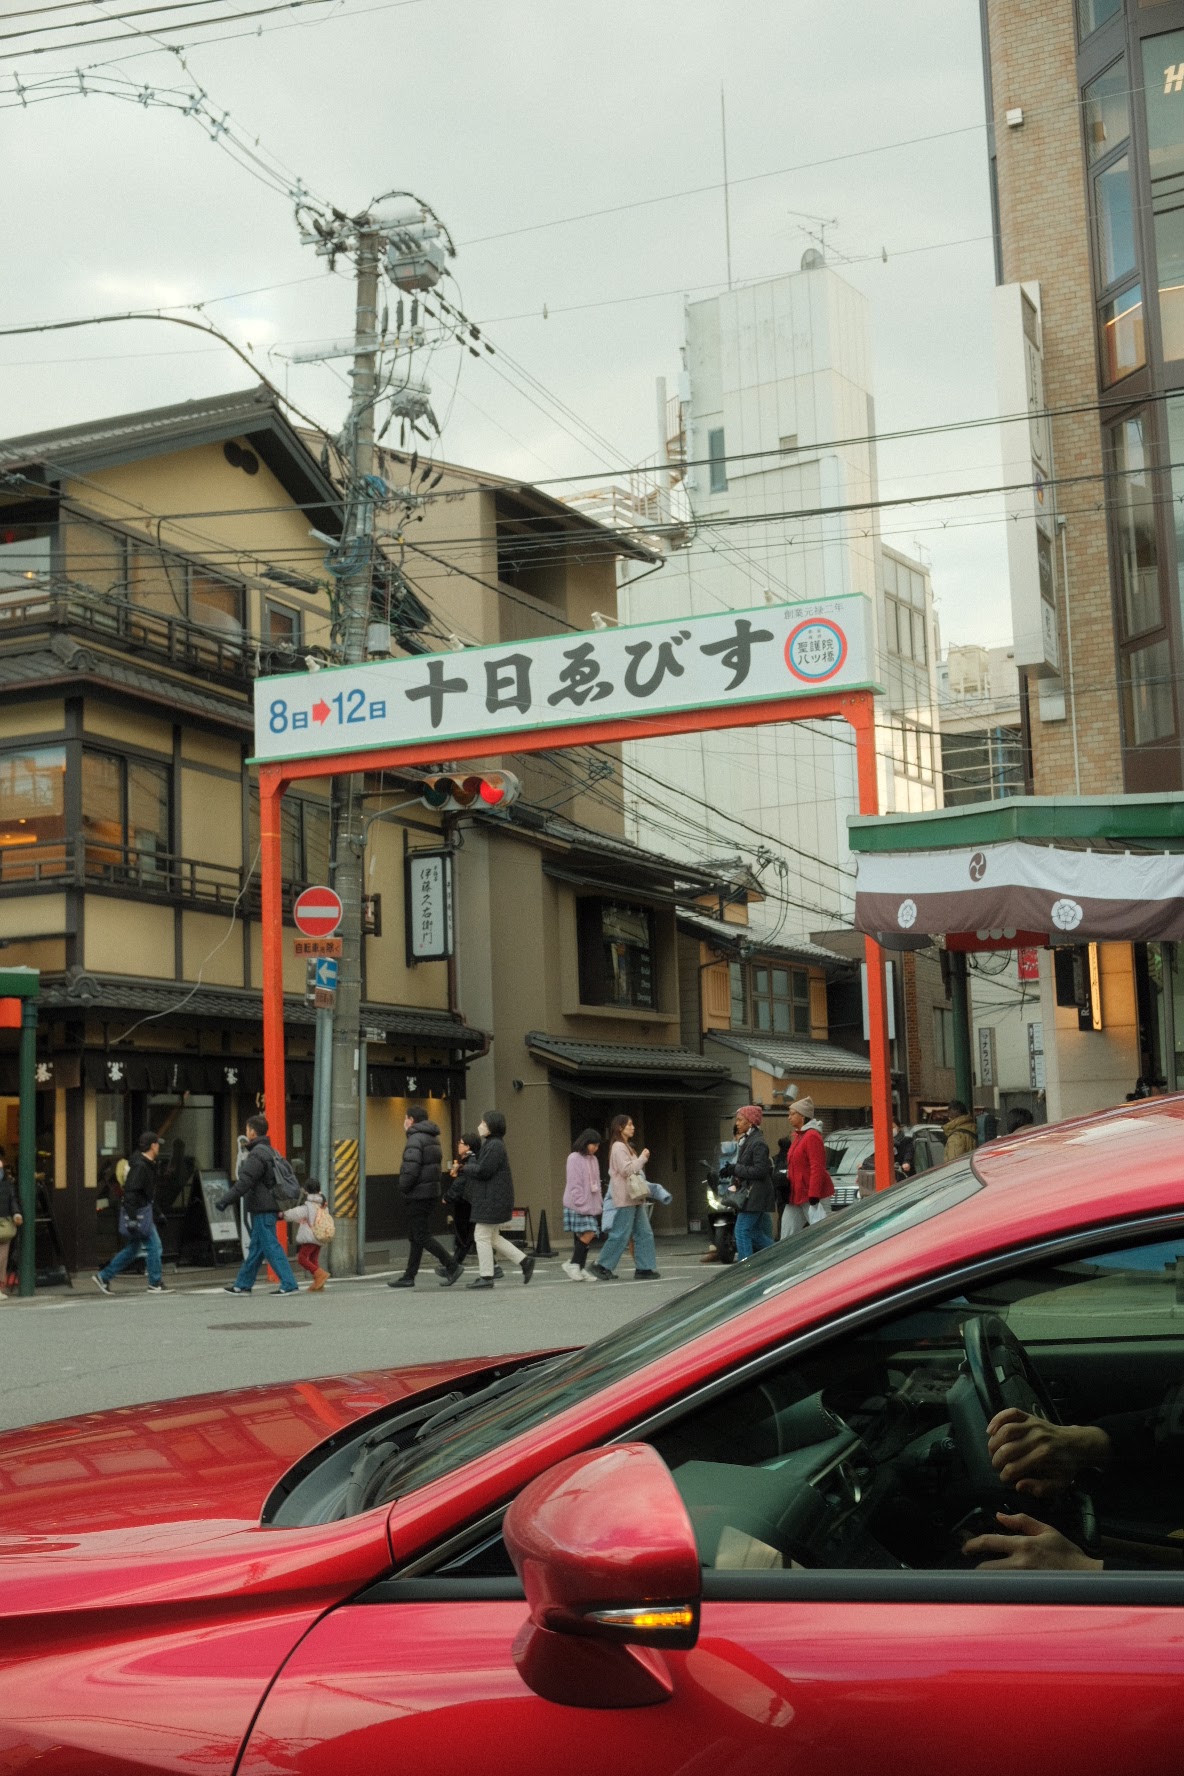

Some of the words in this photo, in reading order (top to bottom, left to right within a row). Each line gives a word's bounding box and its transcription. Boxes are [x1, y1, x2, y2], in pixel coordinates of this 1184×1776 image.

[784, 603, 844, 620] 創業元禄二年
[797, 638, 834, 654] 聖護院
[797, 650, 835, 666] 八ツ橋
[404, 619, 775, 729] 十日ゑびす
[269, 699, 309, 734] 8日
[332, 688, 386, 725] 12日
[420, 868, 433, 944] 伊藤久右衛門
